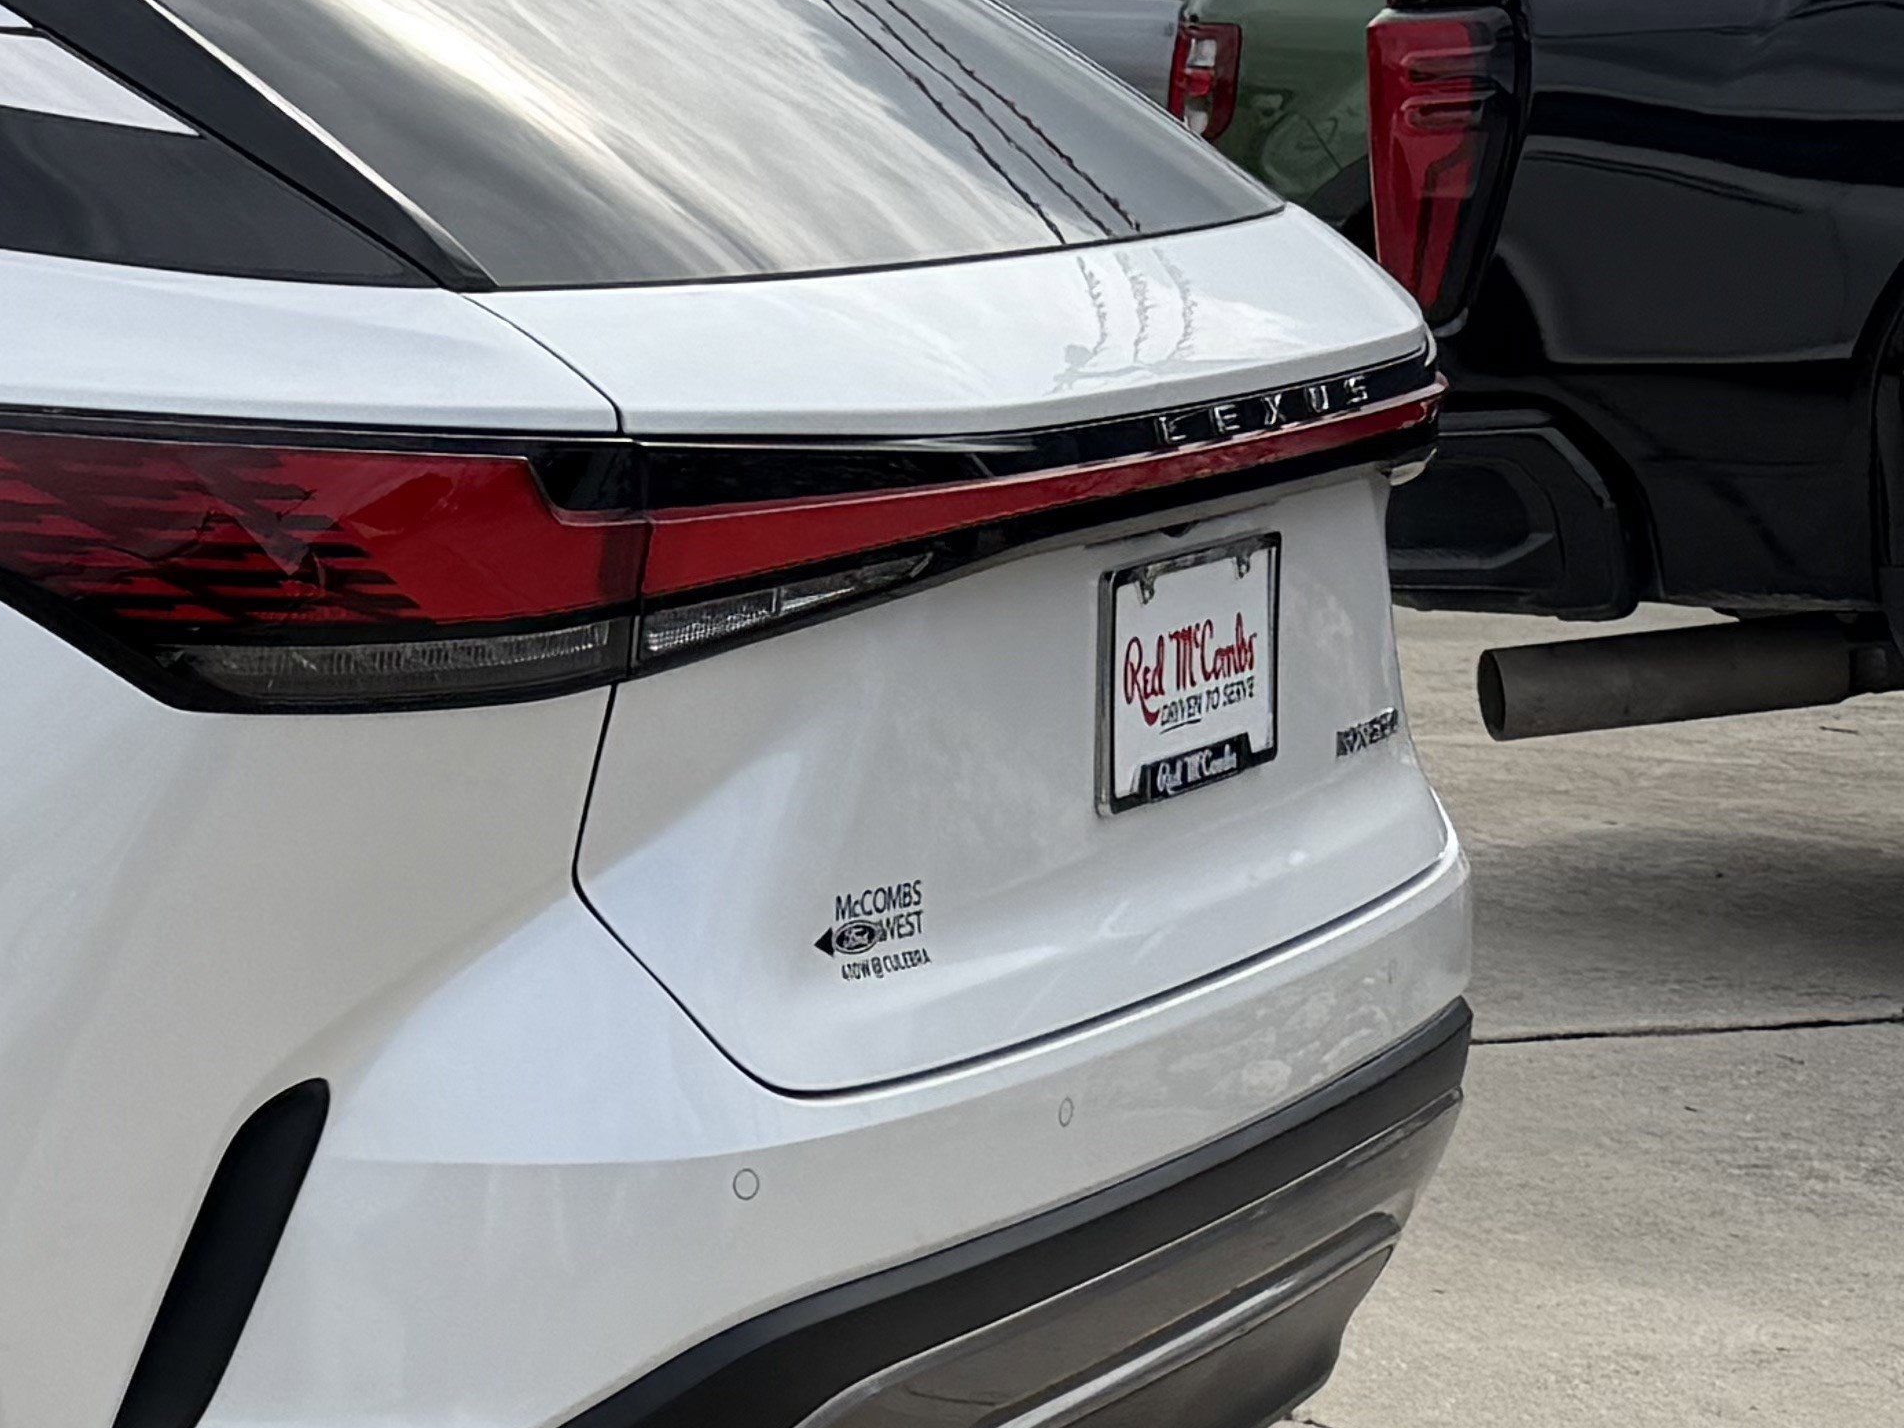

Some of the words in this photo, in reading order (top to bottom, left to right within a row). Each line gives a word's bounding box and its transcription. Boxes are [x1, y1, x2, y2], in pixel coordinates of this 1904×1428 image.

[1155, 374, 1370, 445] LEXUS
[1124, 634, 1166, 726] Red
[1168, 611, 1258, 692] McCombs
[1206, 686, 1221, 713] TO
[835, 879, 923, 922] McCOMBS
[876, 910, 925, 943] WEST
